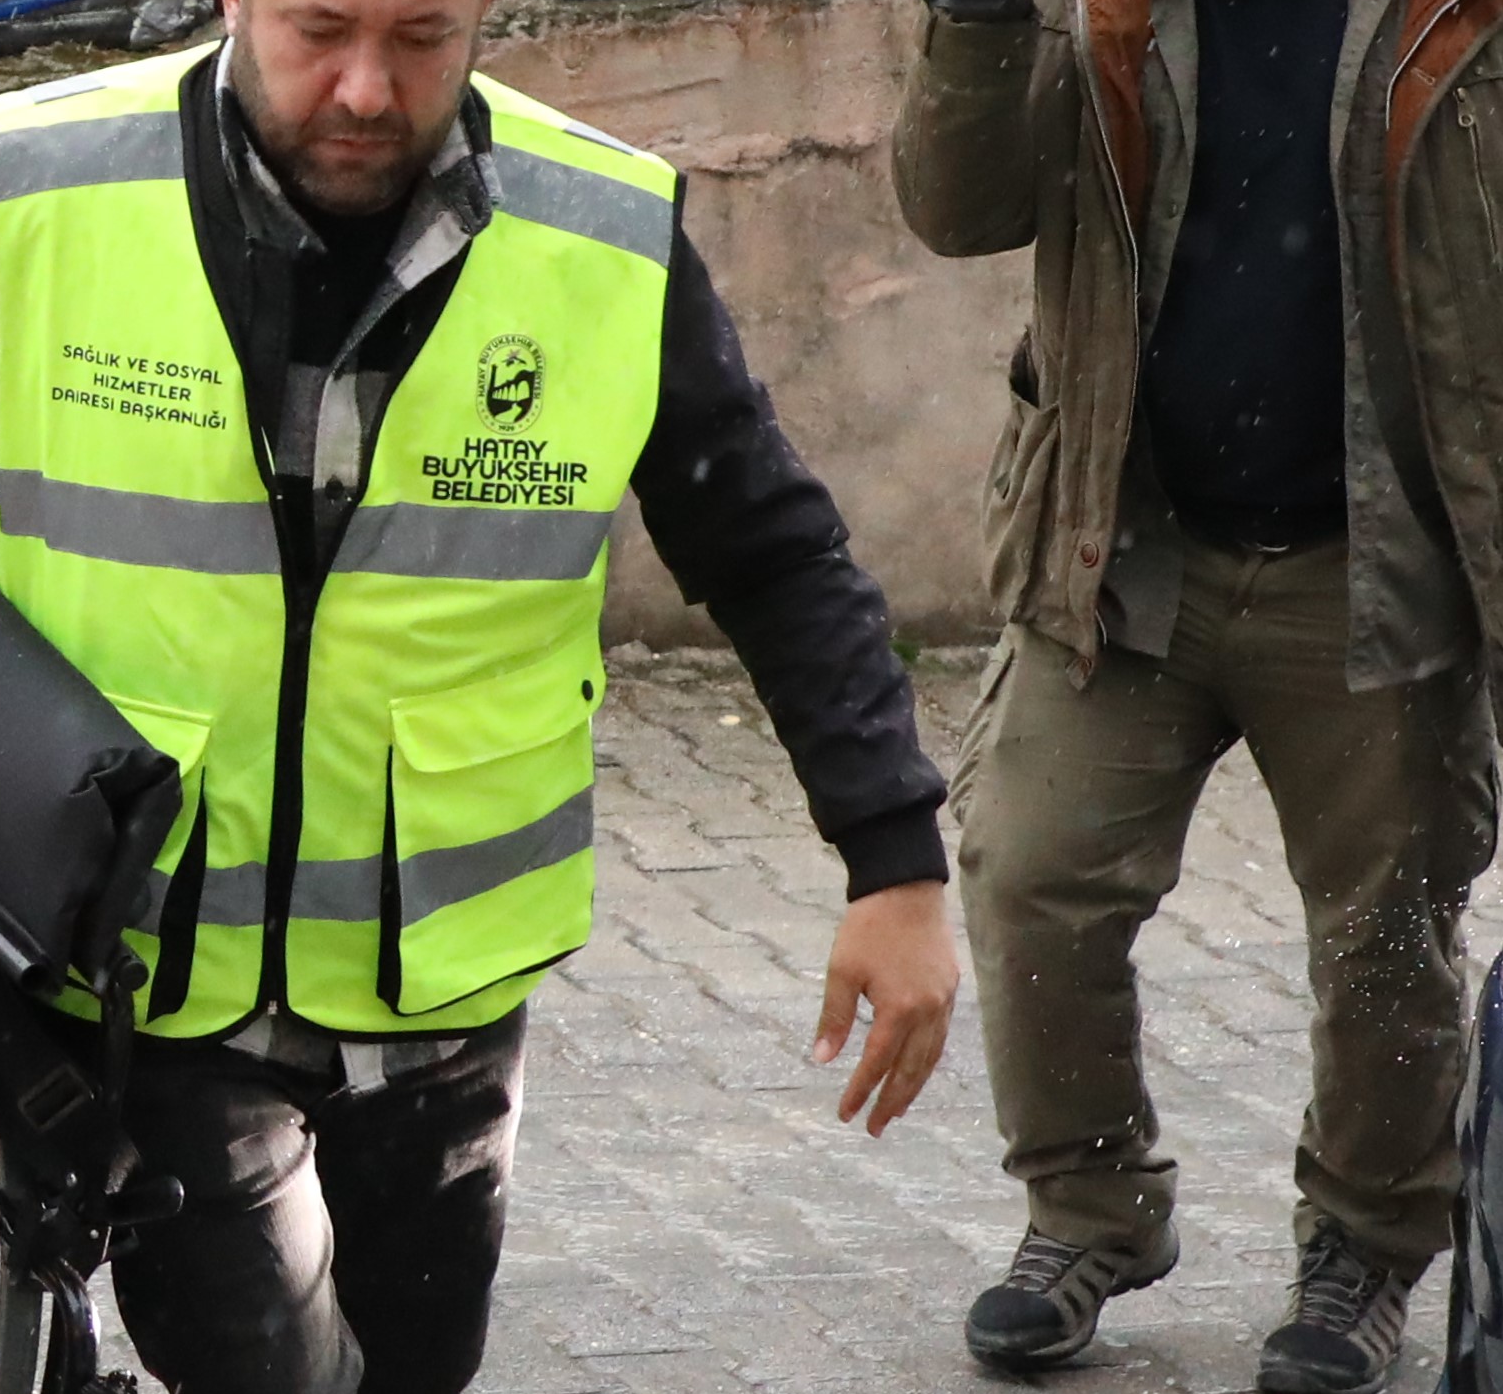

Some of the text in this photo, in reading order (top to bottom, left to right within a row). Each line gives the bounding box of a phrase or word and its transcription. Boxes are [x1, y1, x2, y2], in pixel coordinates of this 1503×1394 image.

[62, 344, 223, 385] SAĞLIK VE SOSYAL
[119, 399, 227, 430] BAŞKANLIĞI
[464, 437, 549, 461] HATAY
